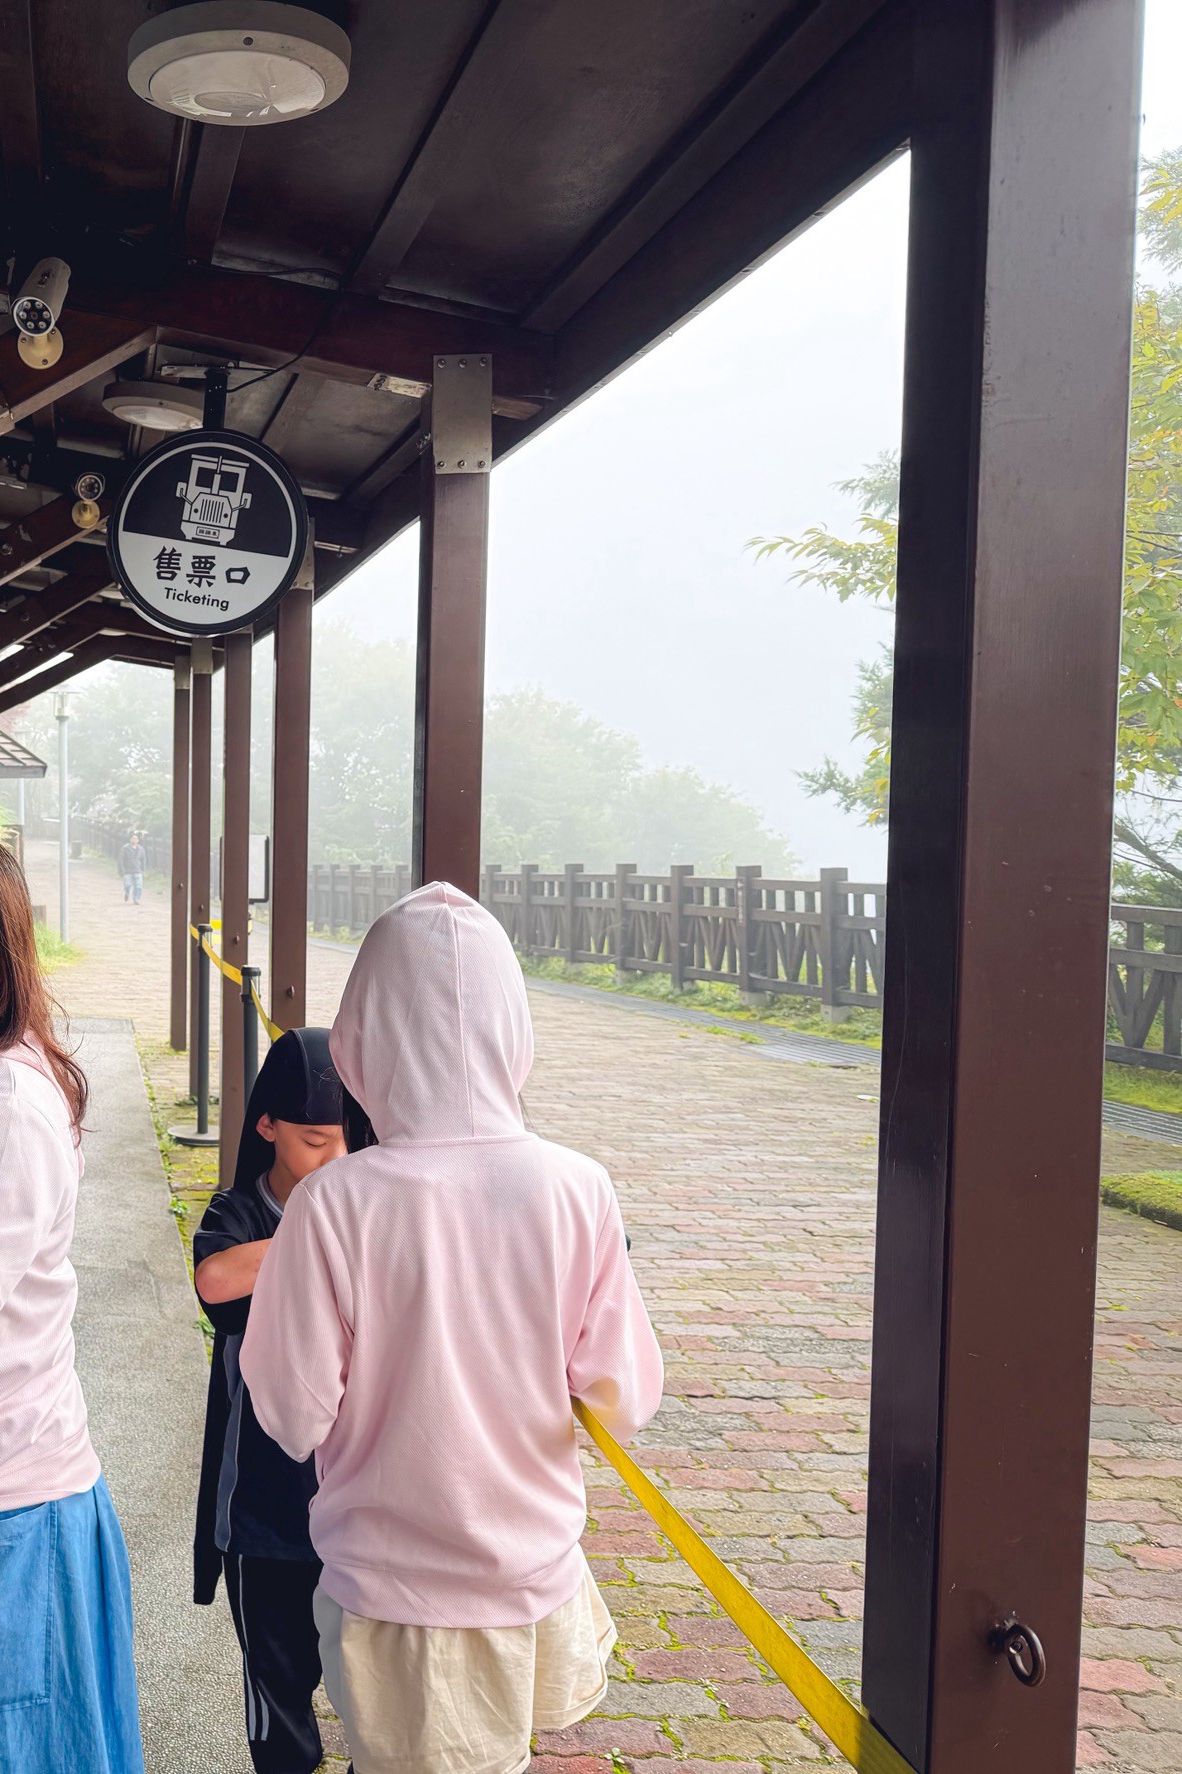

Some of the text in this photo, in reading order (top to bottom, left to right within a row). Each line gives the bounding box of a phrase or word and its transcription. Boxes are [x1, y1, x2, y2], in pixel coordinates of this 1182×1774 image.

[153, 546, 251, 588] 售票口
[164, 587, 230, 612] Ticketing
